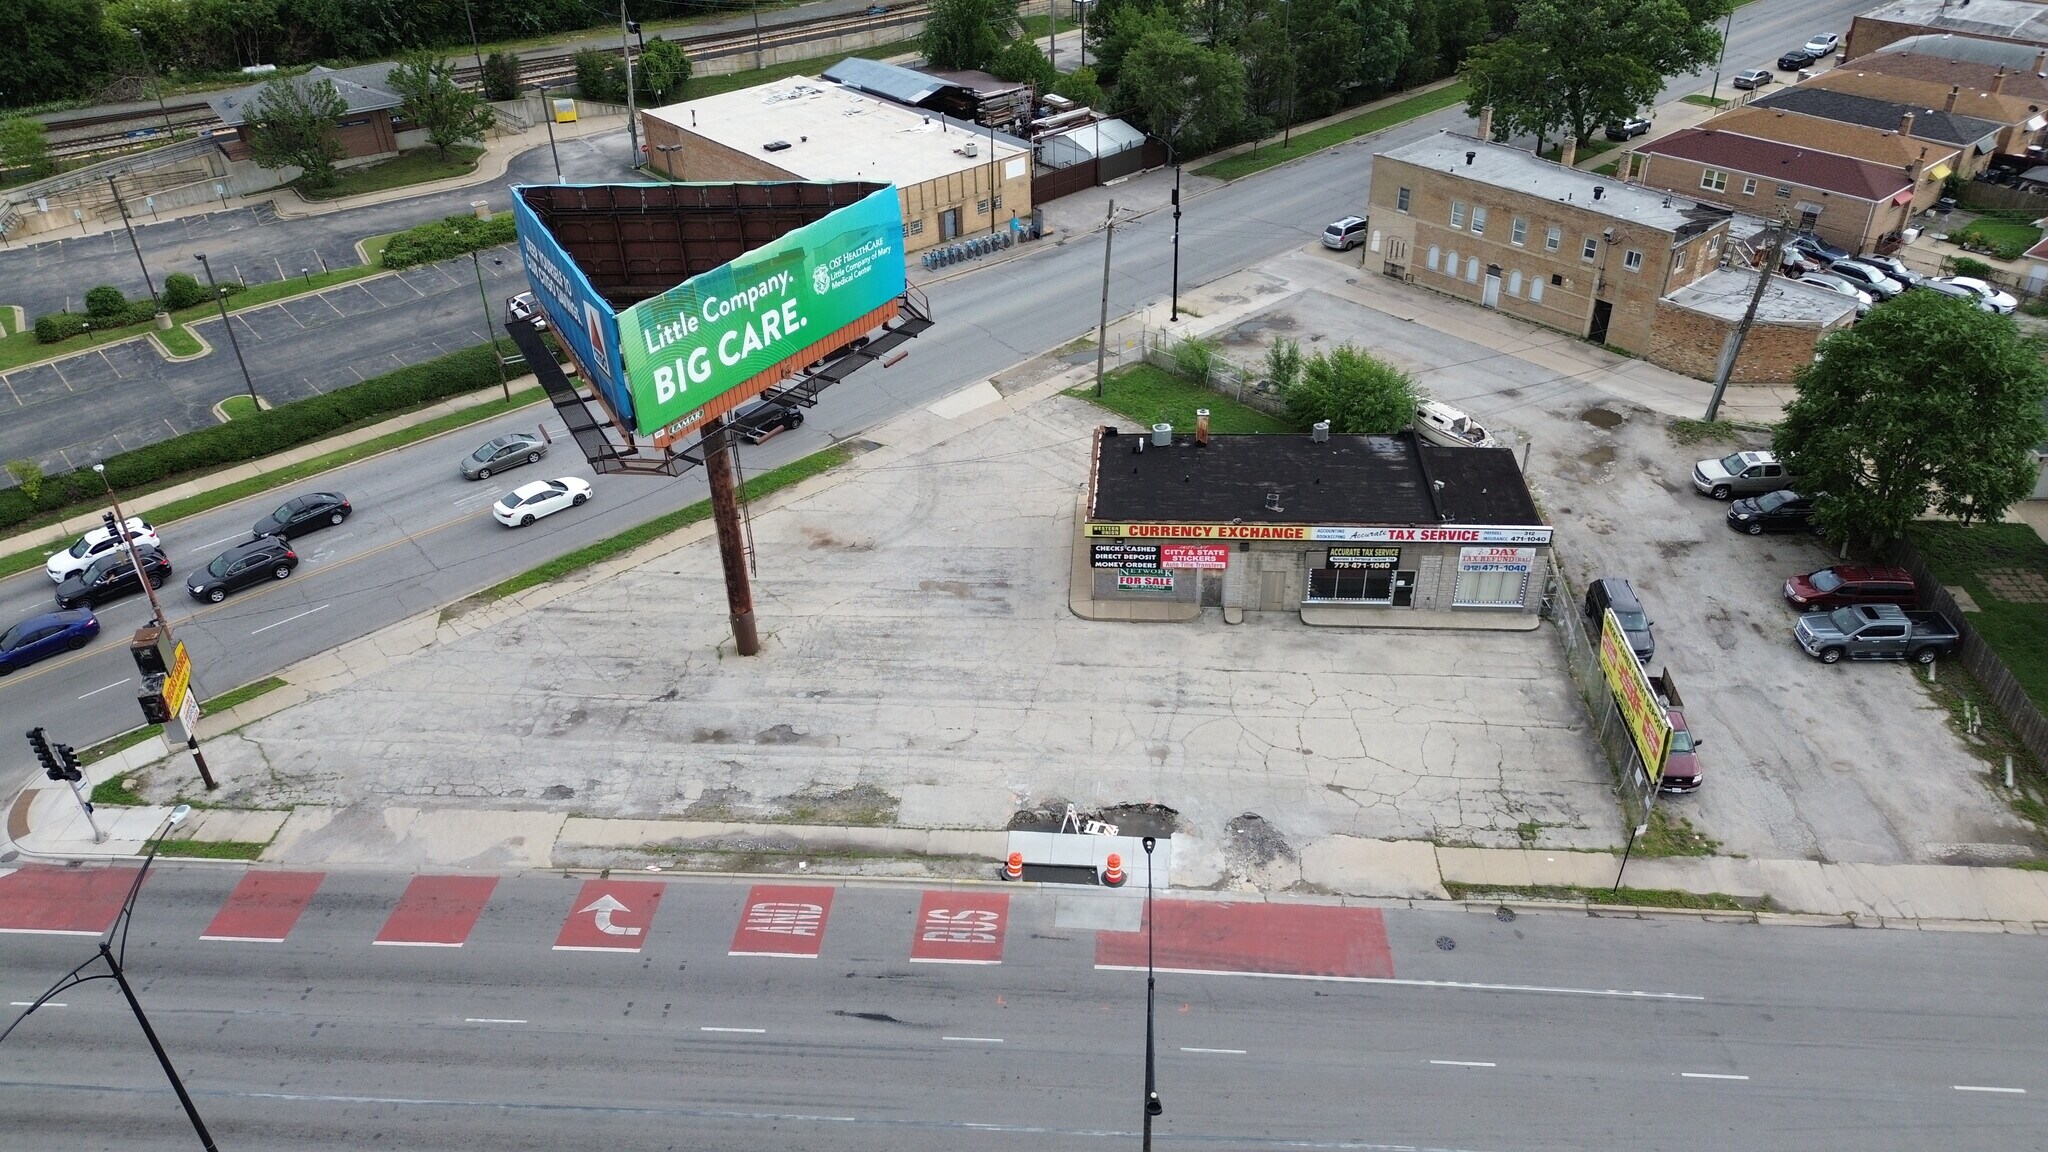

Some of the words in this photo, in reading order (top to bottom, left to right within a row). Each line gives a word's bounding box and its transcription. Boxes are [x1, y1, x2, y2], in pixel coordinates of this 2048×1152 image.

[829, 256, 842, 270] OSF
[830, 268, 845, 280] Little
[845, 255, 871, 273] Company
[871, 252, 878, 260] of
[877, 246, 892, 258] Mary
[831, 272, 854, 290] Medical
[854, 264, 872, 278] Center
[644, 311, 699, 354] Little
[702, 269, 794, 323] Company.
[653, 346, 712, 405] BIG
[718, 297, 808, 366] CARE.
[671, 410, 701, 433] LAMAR
[1128, 526, 1213, 538] CURRENCY
[1218, 526, 1304, 539] EXCHANGE
[1349, 530, 1387, 540] Accurate
[1388, 530, 1416, 541] TAX
[1420, 530, 1480, 541] SERVICE
[1330, 548, 1360, 556] ACCURATE
[1362, 548, 1374, 556] TAX
[1374, 548, 1399, 556] SERVICE
[1489, 548, 1519, 556] DAY
[1120, 576, 1142, 584] FOR
[1144, 577, 1172, 586] SALE
